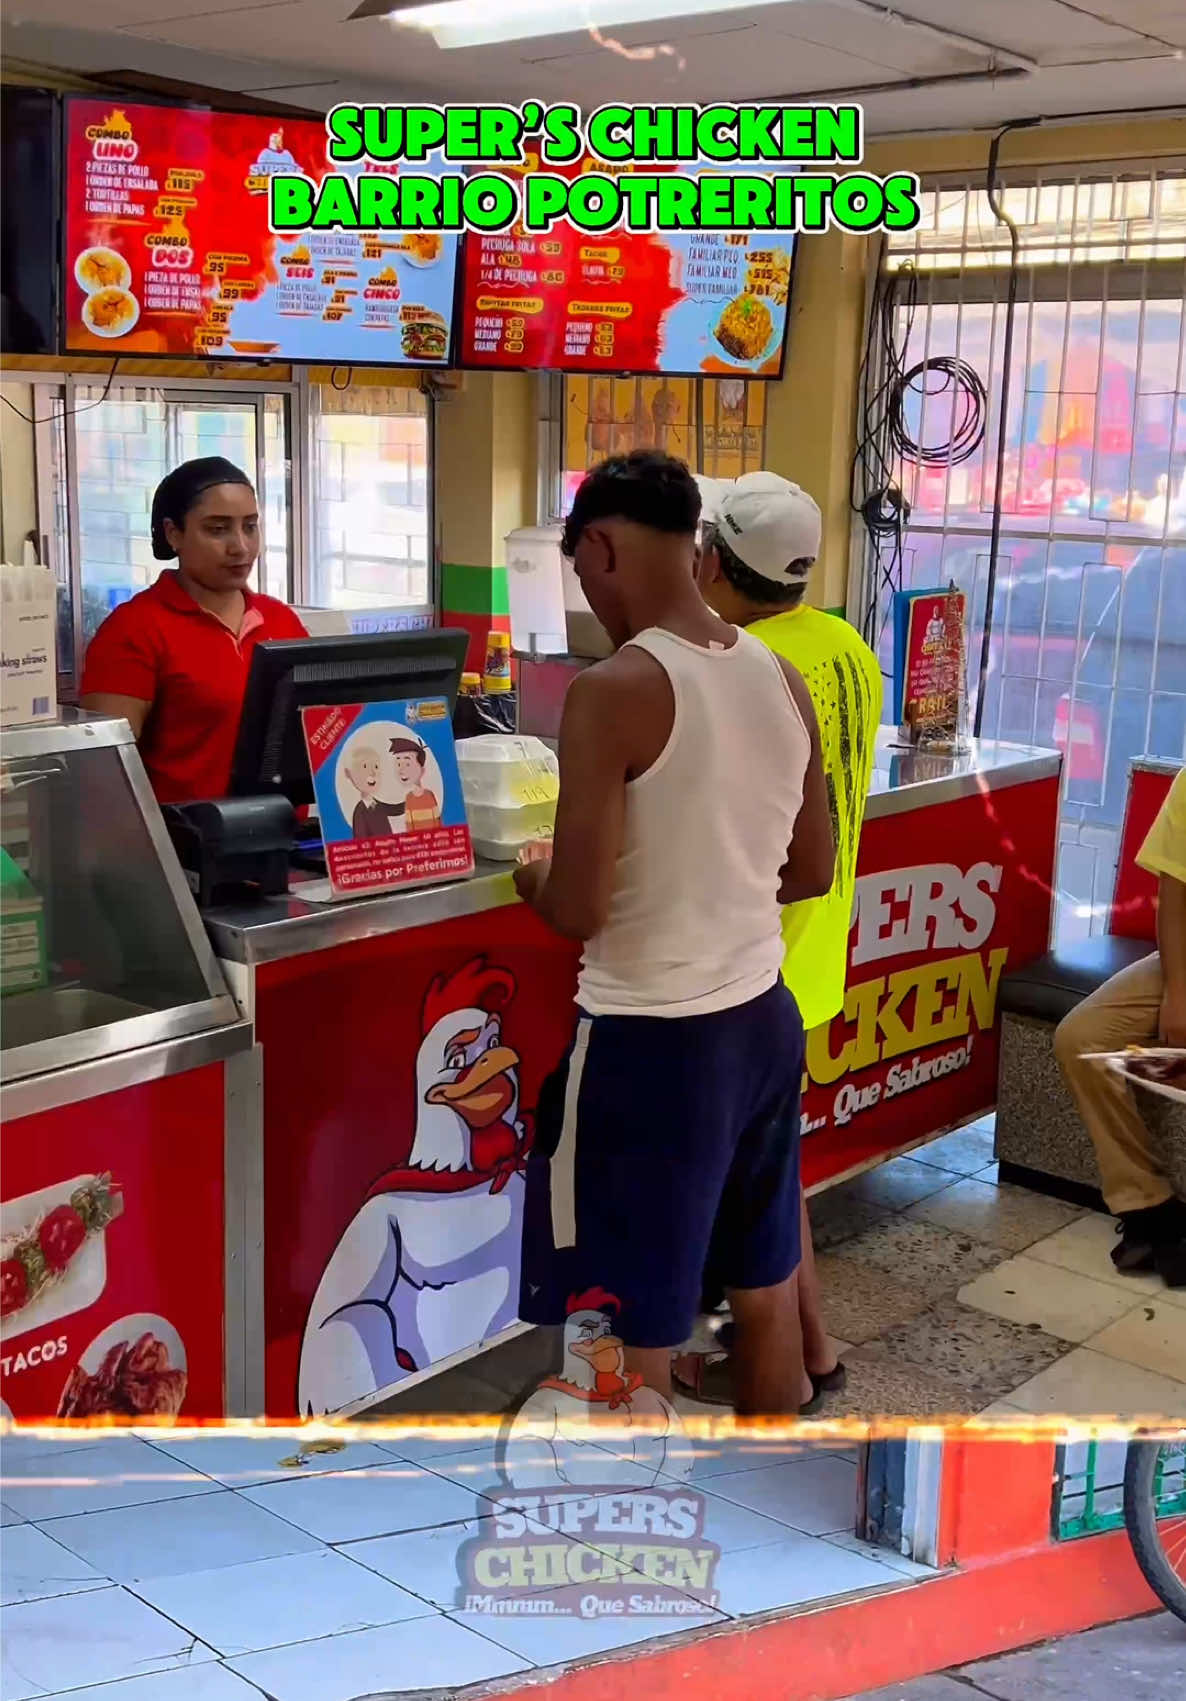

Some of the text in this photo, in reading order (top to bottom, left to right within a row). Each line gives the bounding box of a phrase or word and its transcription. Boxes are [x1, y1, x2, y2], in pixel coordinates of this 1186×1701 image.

[88, 128, 130, 139] COMBO
[97, 142, 135, 158] UNO
[128, 165, 149, 177] POLLO
[147, 235, 188, 246] COMBO
[155, 249, 190, 263] DOS
[280, 256, 309, 265] COMBO
[481, 253, 495, 265] ALA
[689, 247, 723, 261] FAMILIAR
[687, 264, 720, 278] FAMILIAR
[368, 278, 397, 287] COMBO
[364, 288, 400, 300] CINCO
[22, 653, 48, 667] straws
[385, 867, 404, 880] por
[406, 854, 468, 873] Preferimos!
[850, 861, 1003, 967] ERS
[832, 1081, 881, 1126] Que
[883, 1035, 975, 1100] Sabroso!
[1, 1336, 68, 1377] TACOS
